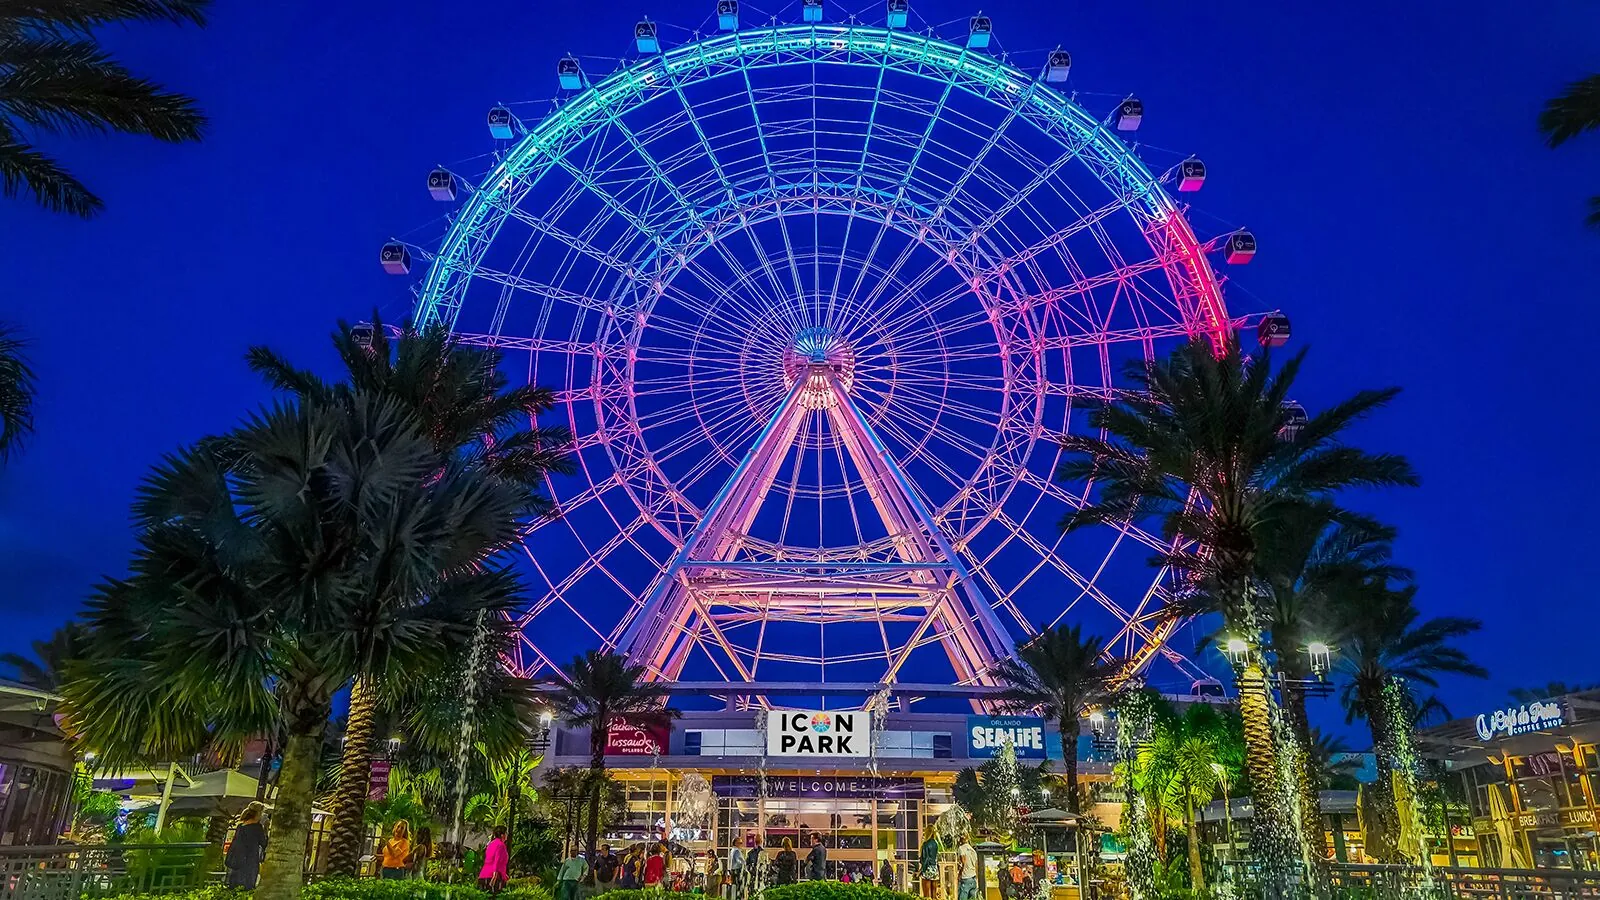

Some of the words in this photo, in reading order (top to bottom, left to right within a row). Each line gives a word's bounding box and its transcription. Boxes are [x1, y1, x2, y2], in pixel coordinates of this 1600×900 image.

[781, 712, 853, 733] ICON
[1513, 722, 1541, 734] COFFEE
[1542, 718, 1563, 729] SHOP
[781, 735, 853, 754] PARK
[775, 781, 857, 792] WELCOME
[1518, 813, 1559, 826] BREAKFAST
[1568, 810, 1597, 823] LUNCH
